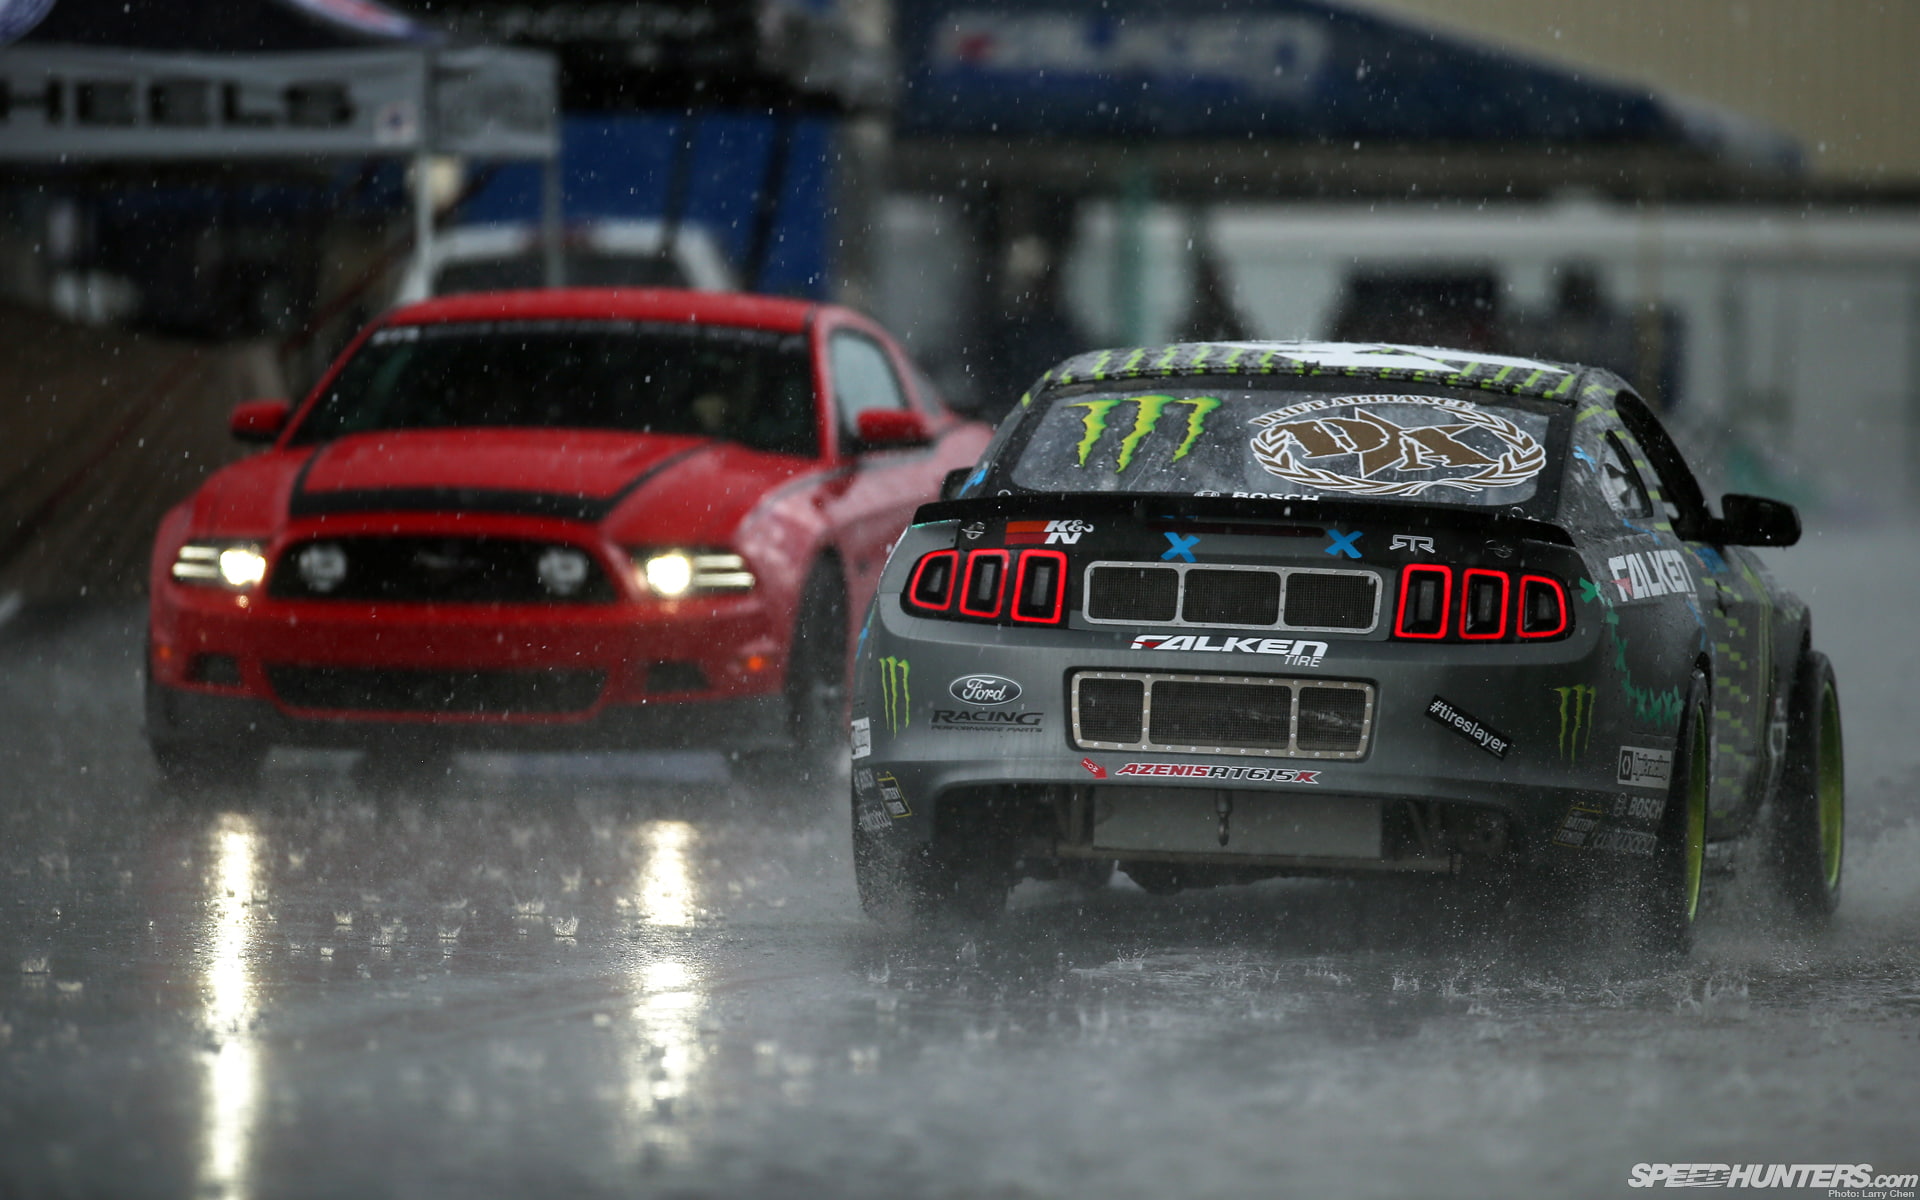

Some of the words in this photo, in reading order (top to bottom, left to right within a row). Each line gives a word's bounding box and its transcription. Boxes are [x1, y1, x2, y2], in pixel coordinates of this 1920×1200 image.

[1608, 549, 1696, 602] FALKEN
[1129, 634, 1329, 658] FALKEN
[1284, 654, 1322, 668] TIRE
[962, 678, 1008, 702] Ford
[931, 709, 1044, 726] RACING
[931, 724, 1004, 732] PERFORMANCE
[1428, 699, 1508, 754] #tireslayer
[1628, 796, 1666, 820] BOSCH
